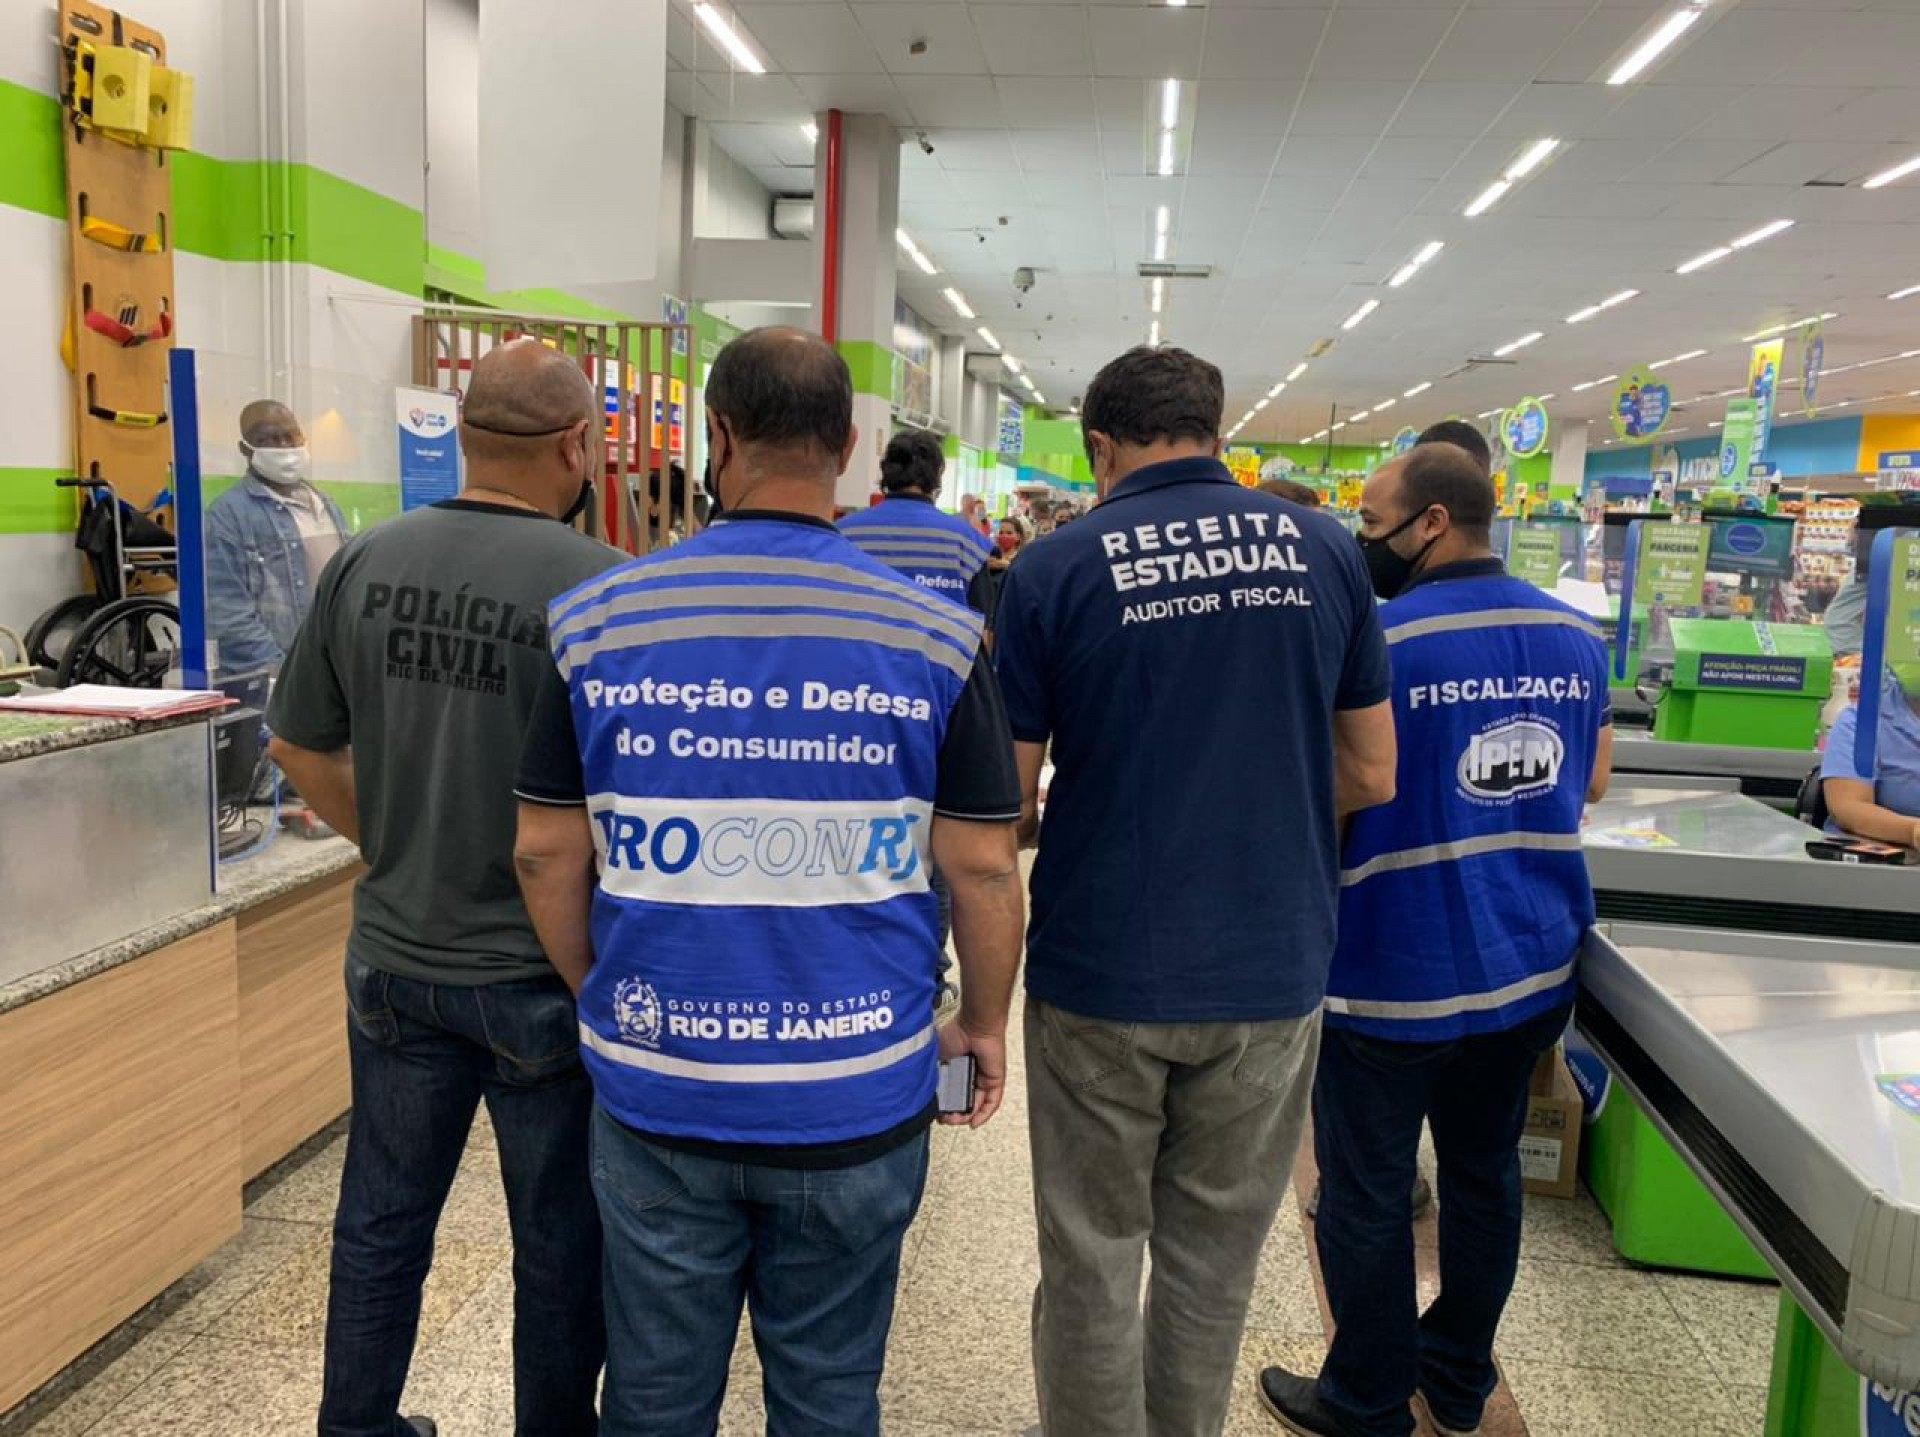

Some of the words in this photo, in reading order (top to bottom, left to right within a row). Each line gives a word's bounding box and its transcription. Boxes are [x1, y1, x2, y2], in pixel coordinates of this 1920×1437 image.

[1101, 512, 1303, 558] RECEITA
[1110, 544, 1309, 592] ESTADUAL
[362, 582, 547, 650] POLÍCIA
[1121, 593, 1222, 625] AUDITOR
[1230, 586, 1312, 609] FISCAL
[386, 663, 415, 679] RIO
[387, 627, 507, 682] CIVIL
[583, 677, 753, 713] Proteção
[765, 686, 789, 709] e
[802, 681, 931, 721] Defesa
[616, 728, 656, 757] do
[668, 728, 897, 765] Consumidor
[1468, 735, 1559, 786] IPEM
[668, 999, 770, 1014] GOVERNO
[782, 1002, 810, 1015] DO
[822, 989, 892, 1014] ESTADO
[668, 1014, 723, 1040] RIO
[729, 1017, 769, 1040] DE
[776, 1006, 894, 1040] JANEIRO
